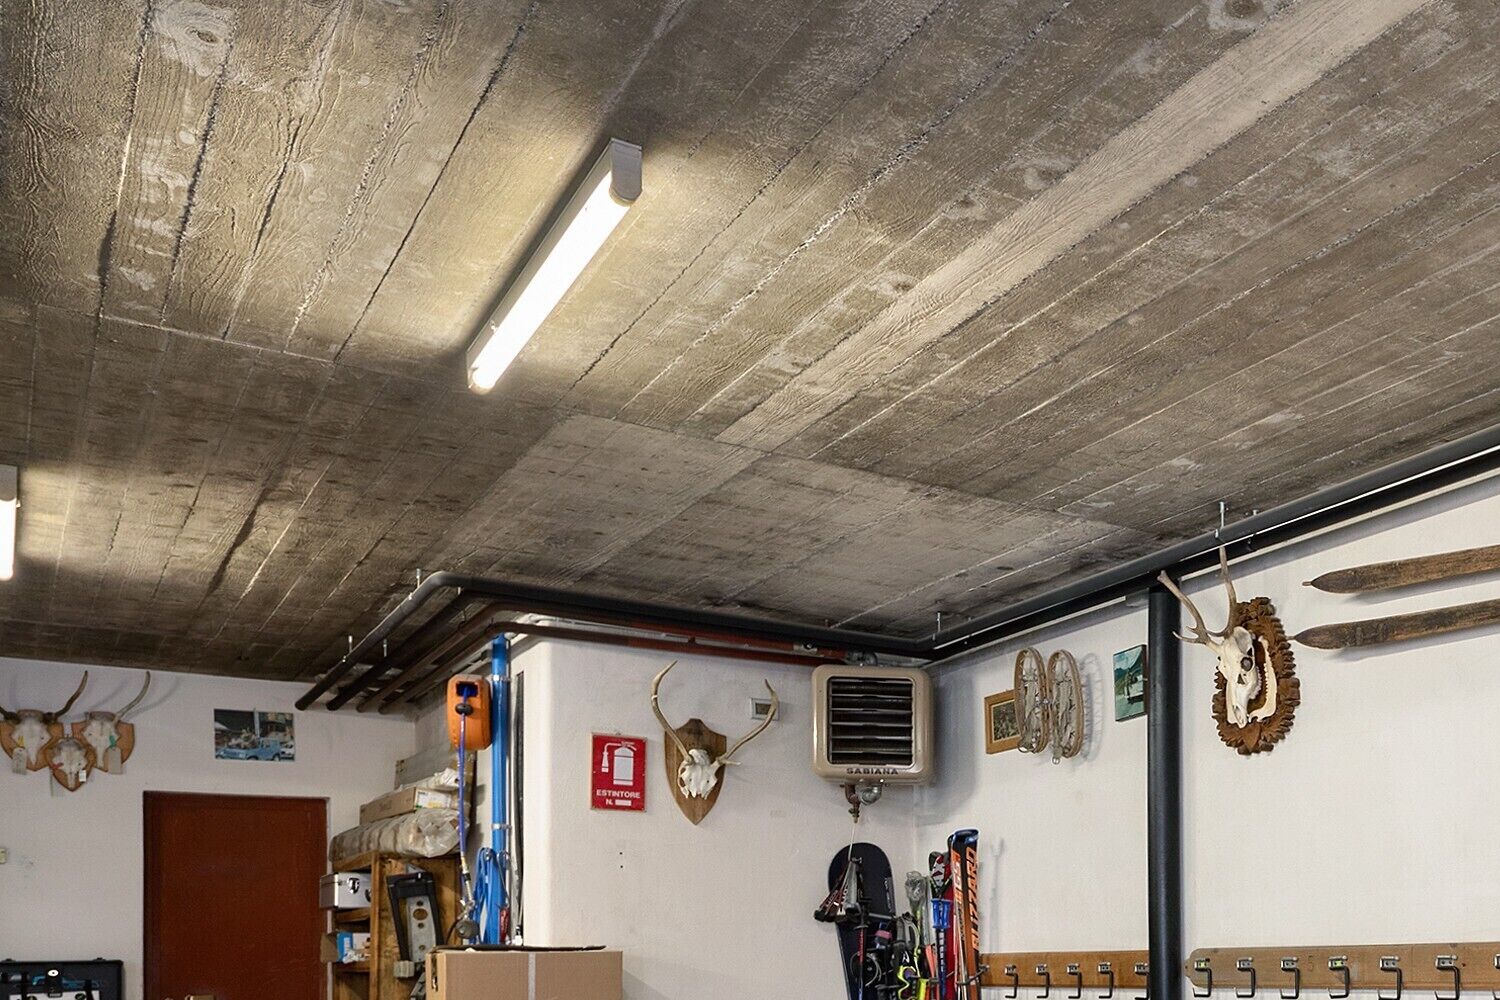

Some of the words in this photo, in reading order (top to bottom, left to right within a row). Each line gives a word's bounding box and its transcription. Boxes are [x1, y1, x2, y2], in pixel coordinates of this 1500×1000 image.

[847, 767, 899, 775] SABIANA
[596, 789, 641, 799] ESTINTORE
[966, 846, 980, 951] BLIZZARD
